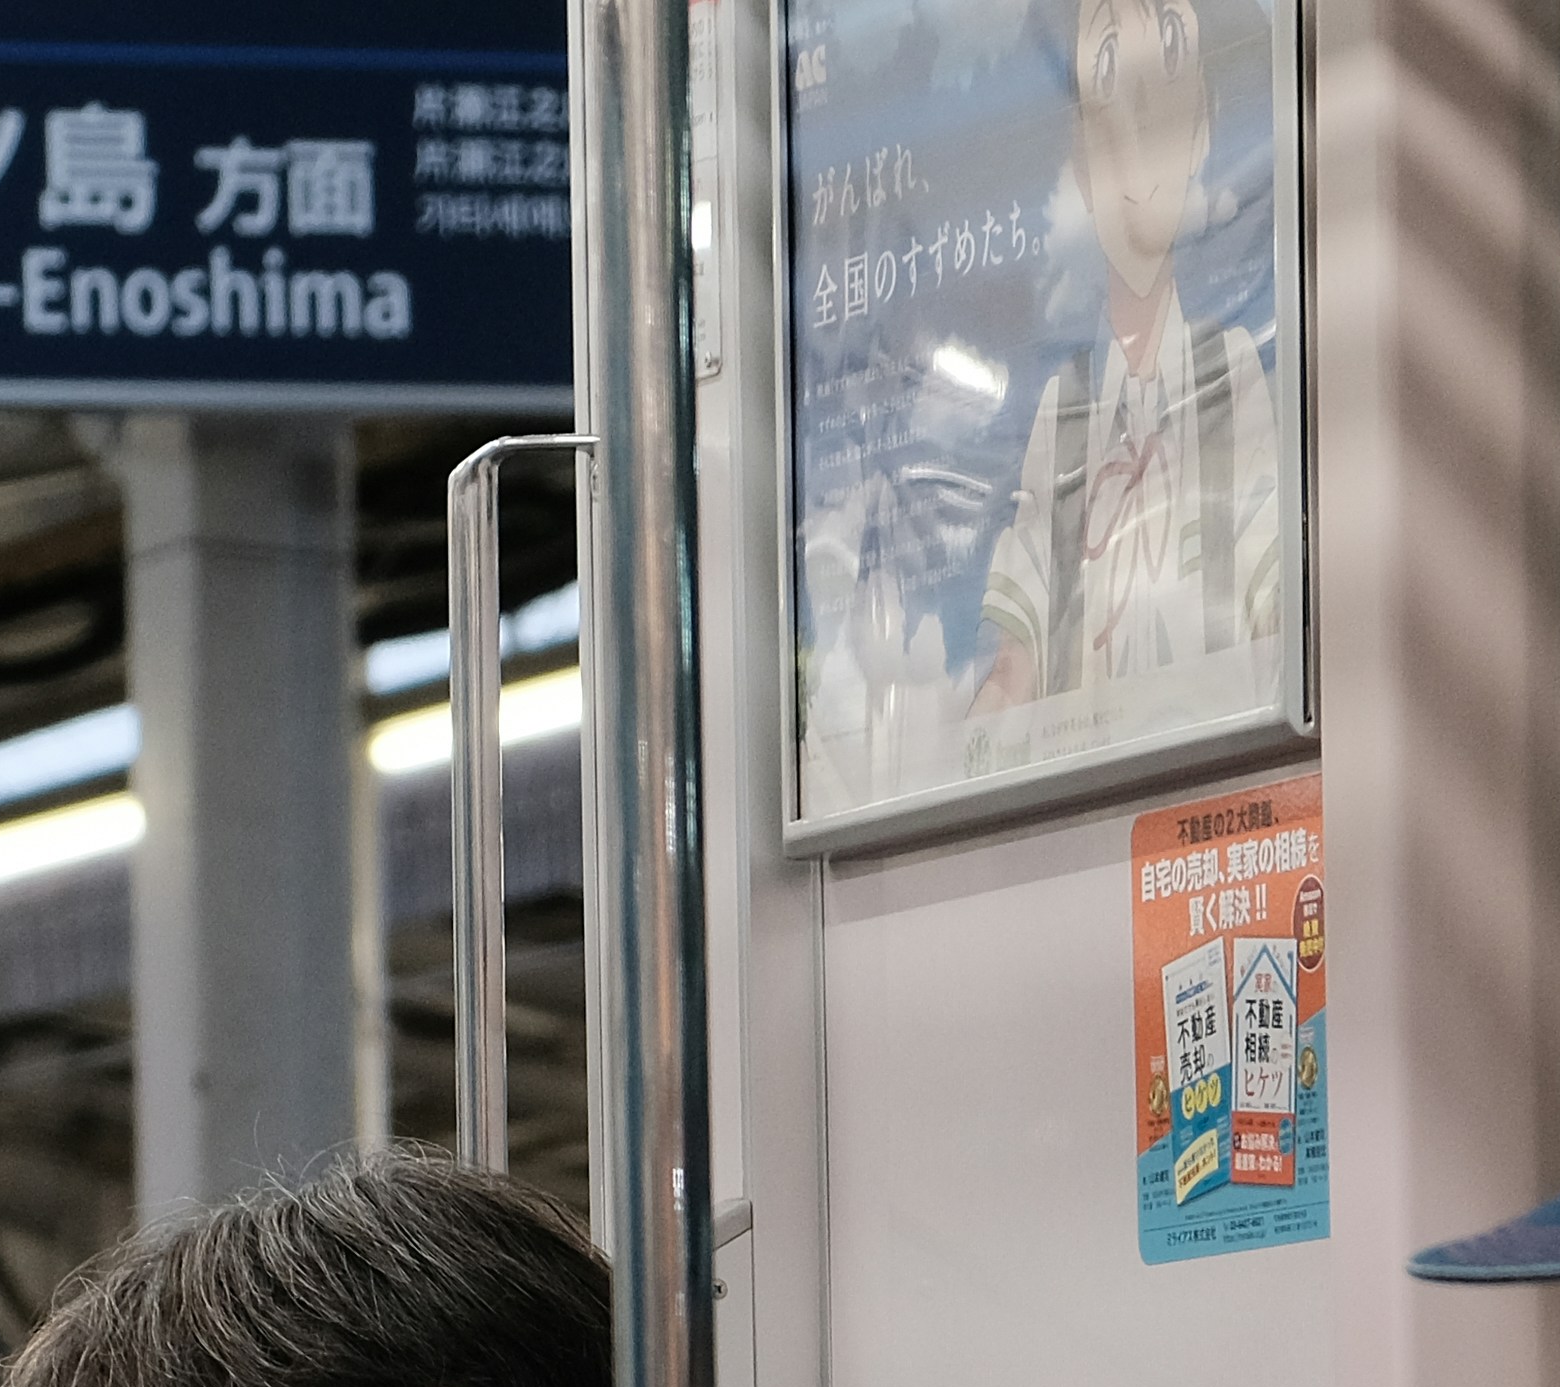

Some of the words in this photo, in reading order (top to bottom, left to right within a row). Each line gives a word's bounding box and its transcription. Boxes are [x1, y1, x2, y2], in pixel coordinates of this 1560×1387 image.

[795, 44, 827, 91] AC
[194, 134, 376, 238] 方面
[812, 143, 929, 226] がんばれ、
[812, 200, 1041, 328] 全国のすずめたち。
[1141, 826, 1320, 903] 自宅の売却、実家の相続を
[1177, 1004, 1218, 1050] 不動産
[1245, 999, 1284, 1029] 不動産
[1244, 1066, 1284, 1098] ヒケツ
